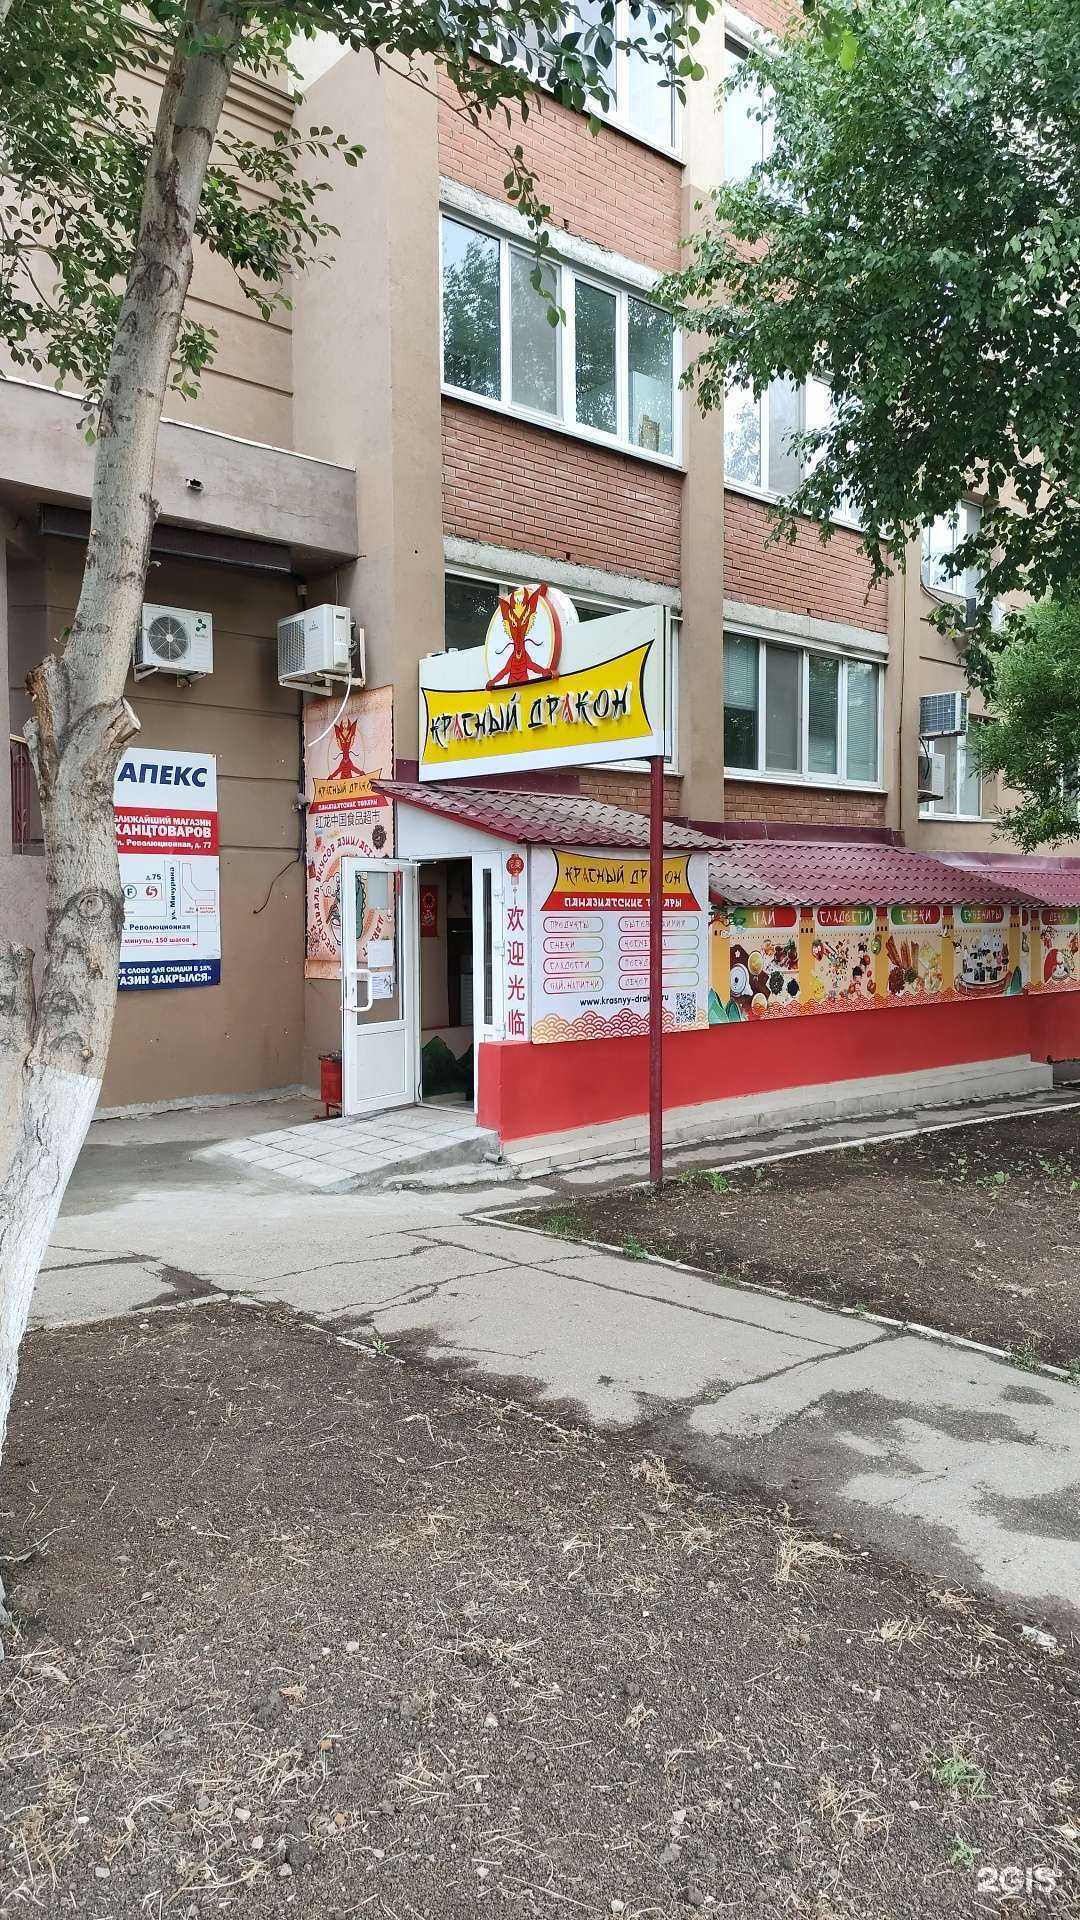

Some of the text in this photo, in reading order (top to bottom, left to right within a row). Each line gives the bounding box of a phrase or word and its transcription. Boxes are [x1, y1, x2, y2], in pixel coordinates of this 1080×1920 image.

[430, 682, 632, 749] КРАСНЫЙ ДРАКОН
[117, 763, 207, 787] АПЕКС
[173, 818, 212, 827] МАГАЗИН
[152, 873, 162, 881] 75
[565, 865, 682, 886] КРАСНЫЙ ДРОН
[564, 897, 682, 908] ПАНАЗИАТСКИЕ ТАРЫ
[753, 908, 775, 925] ЧАЙ
[820, 909, 870, 924] СЛАДОСТИ
[901, 909, 931, 924] СНЕКИ
[550, 941, 575, 951] СНЕКИ
[127, 965, 150, 975] СЛОВО
[166, 965, 193, 973] СКИДКИ
[507, 905, 525, 1036] 欢迎光临
